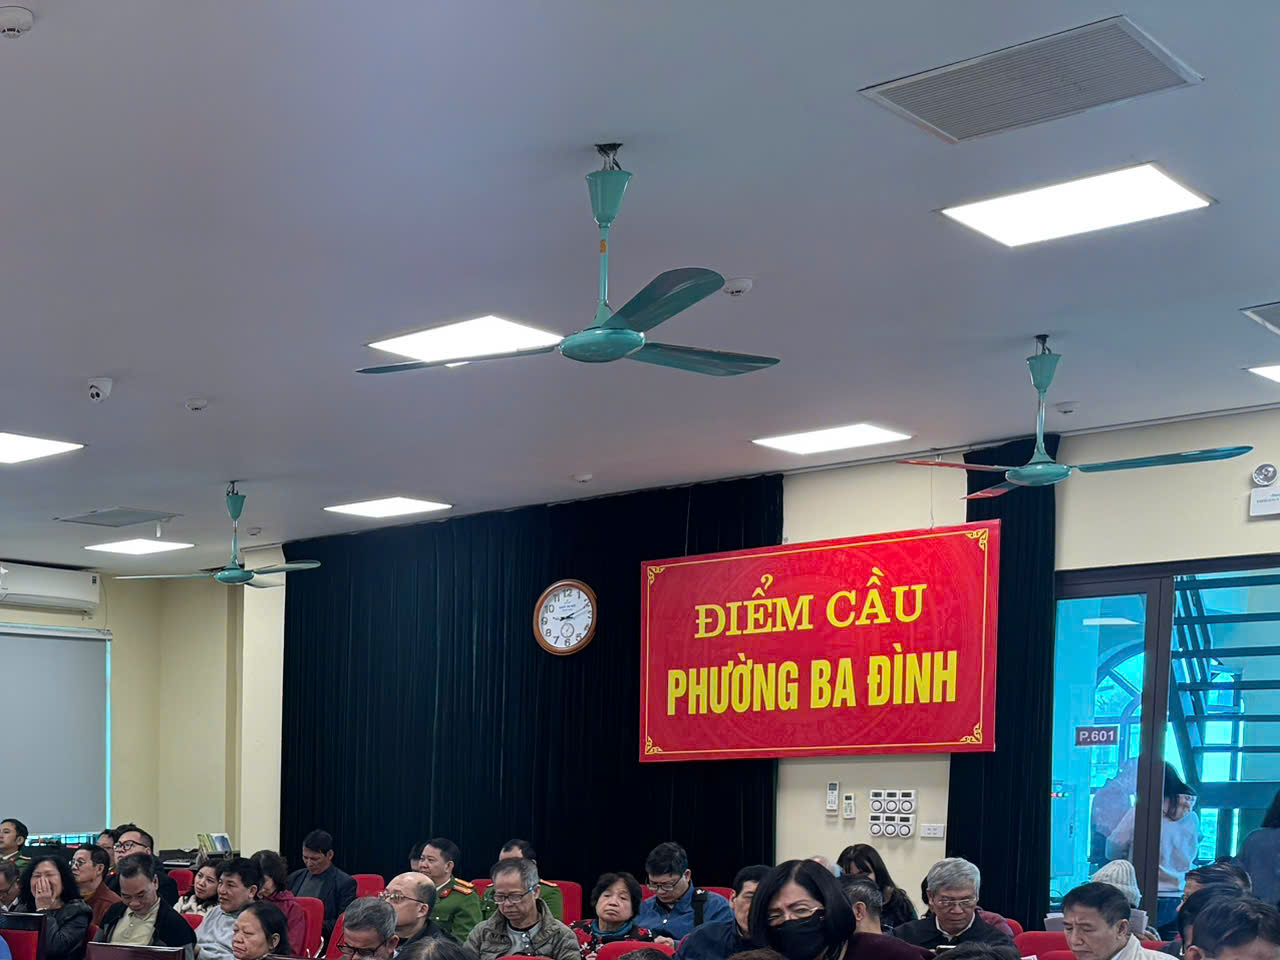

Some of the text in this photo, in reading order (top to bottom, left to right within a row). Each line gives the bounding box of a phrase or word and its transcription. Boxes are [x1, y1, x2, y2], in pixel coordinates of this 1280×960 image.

[694, 566, 928, 639] ĐIỂM CẦU
[667, 642, 958, 716] PHƯỜNG BA ĐÌNH
[1079, 730, 1114, 742] P.601
